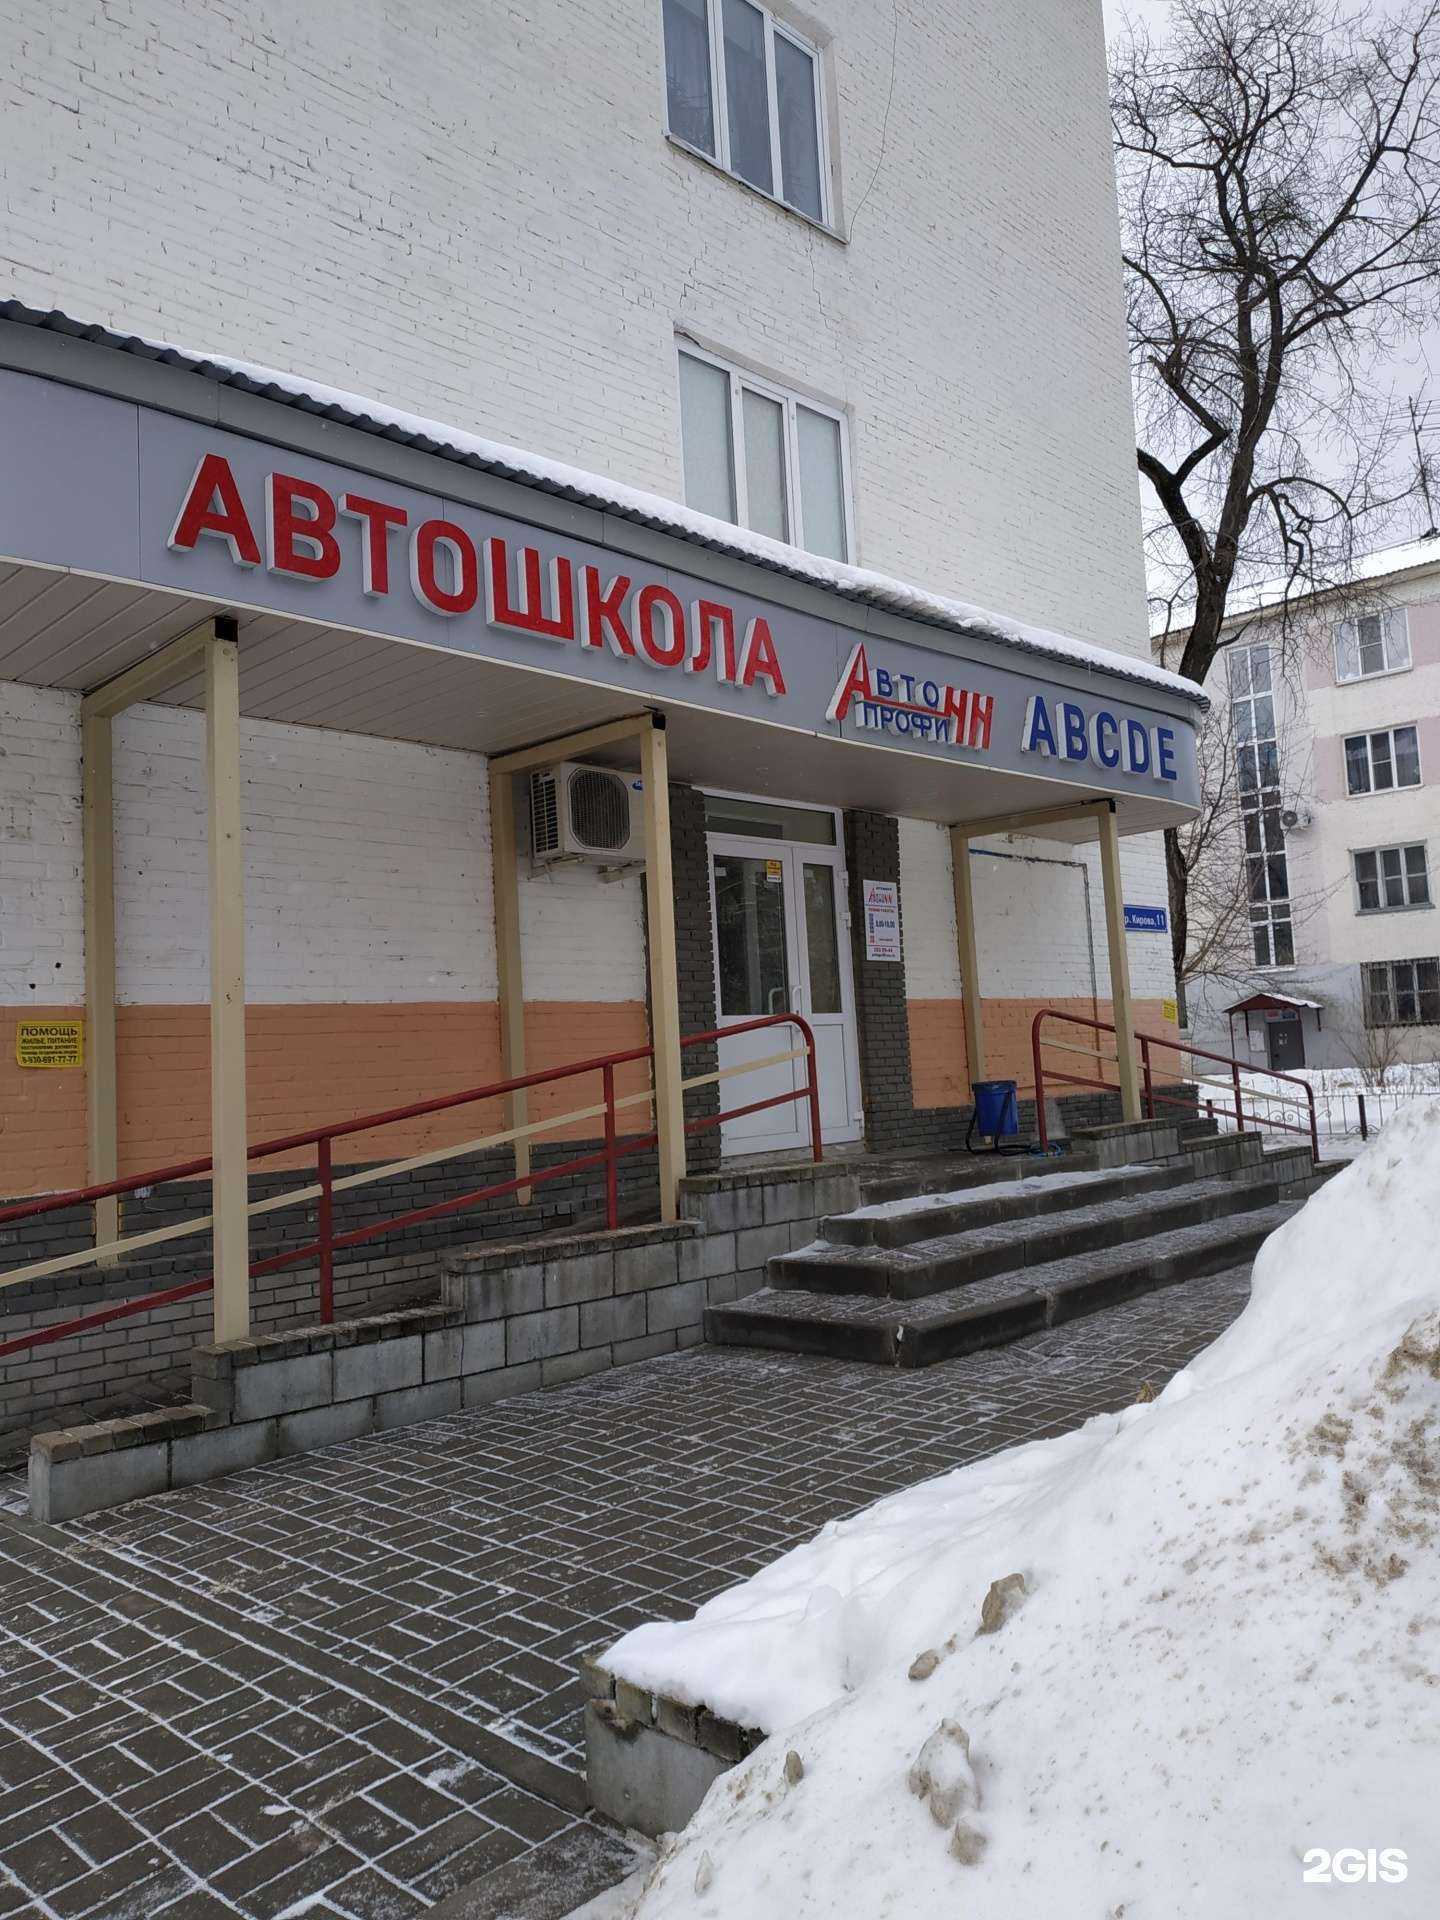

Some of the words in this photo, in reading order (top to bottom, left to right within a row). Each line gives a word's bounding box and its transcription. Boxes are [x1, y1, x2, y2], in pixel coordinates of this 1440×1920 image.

[167, 453, 787, 697] АВТОШКОЛА
[855, 702, 950, 743] ПРОФИ
[1021, 695, 1178, 782] ABCDE
[21, 1027, 78, 1037] ПОМОЩЬ
